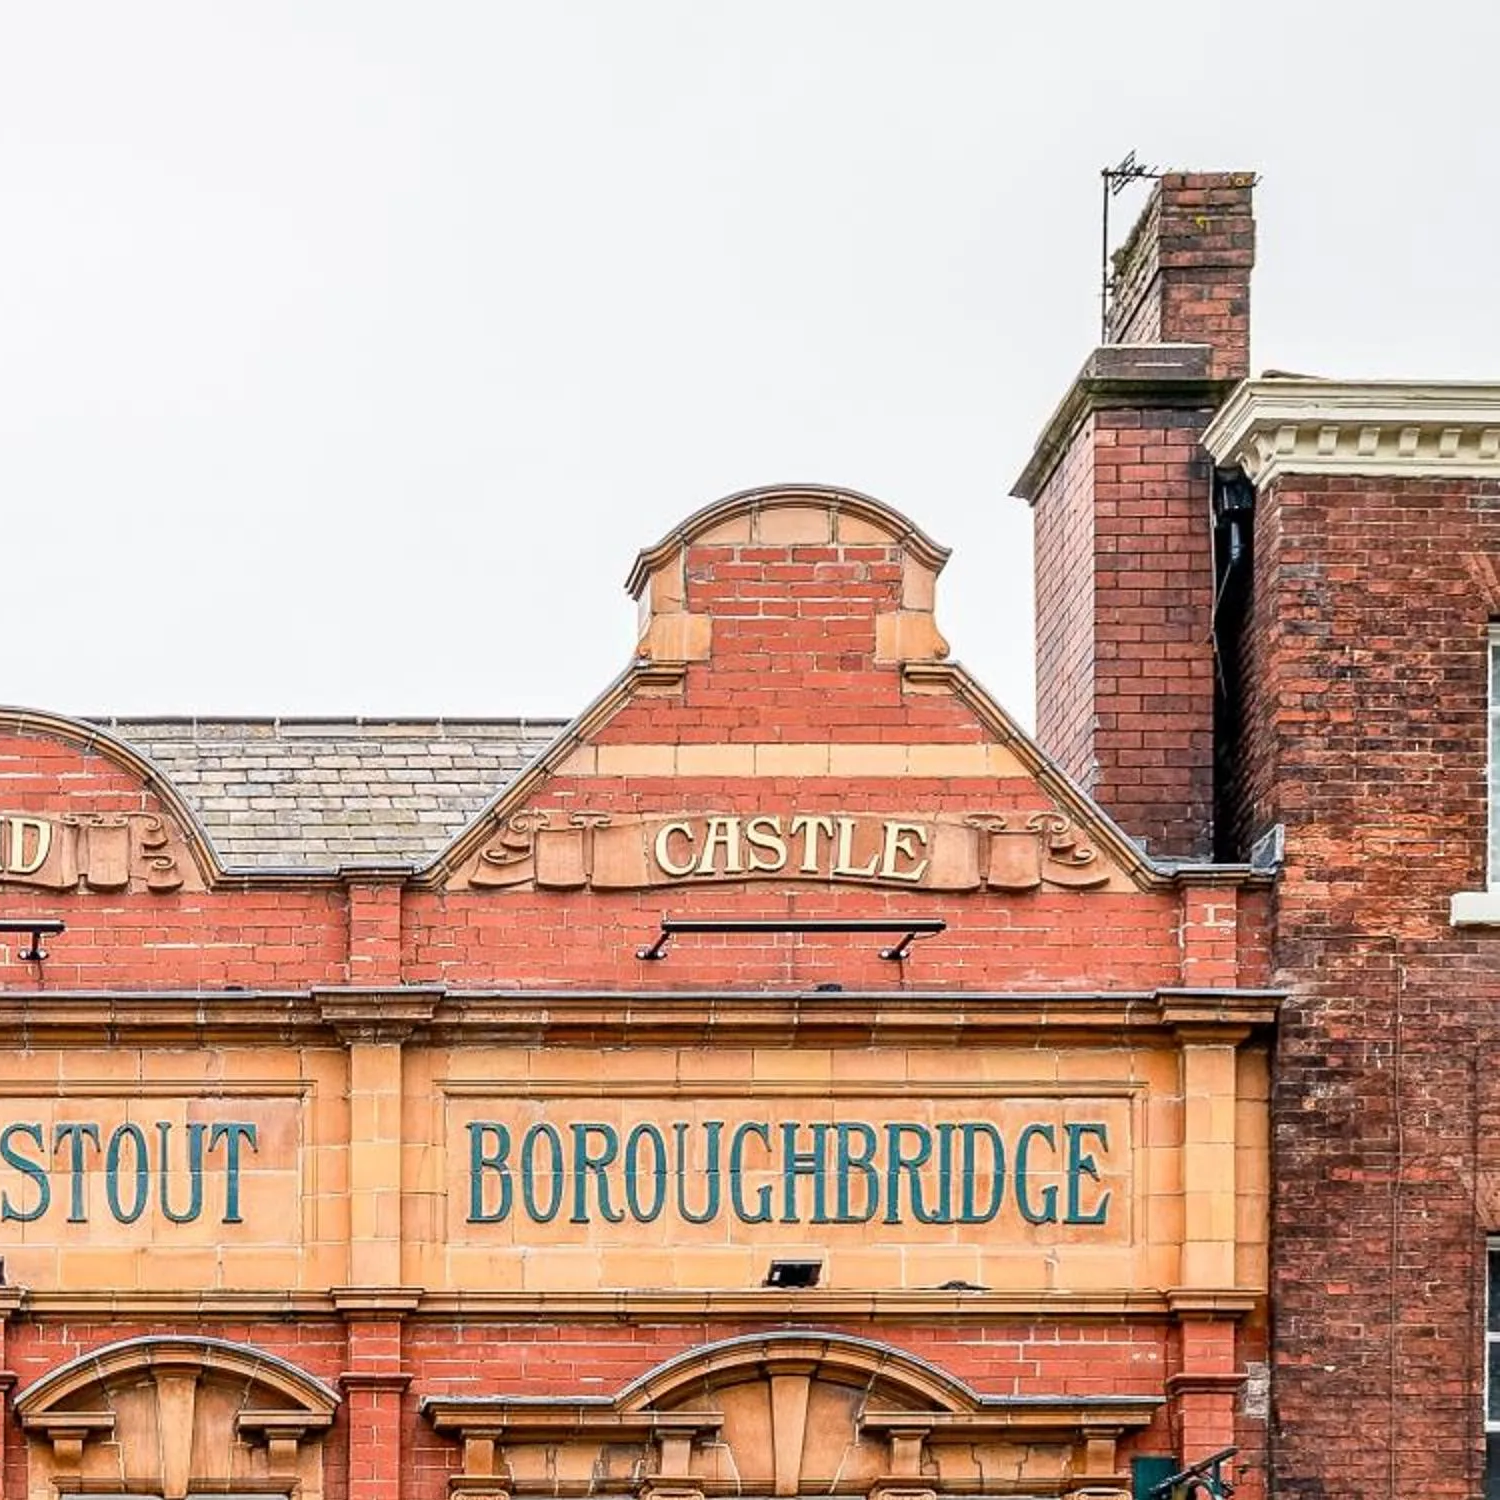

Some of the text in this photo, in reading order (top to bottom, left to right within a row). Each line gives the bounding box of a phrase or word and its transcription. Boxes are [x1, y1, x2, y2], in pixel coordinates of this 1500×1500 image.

[654, 815, 929, 882] CASTLE
[0, 1121, 259, 1225] STOUT
[465, 1121, 1113, 1225] BOROUGHBRIDGE
